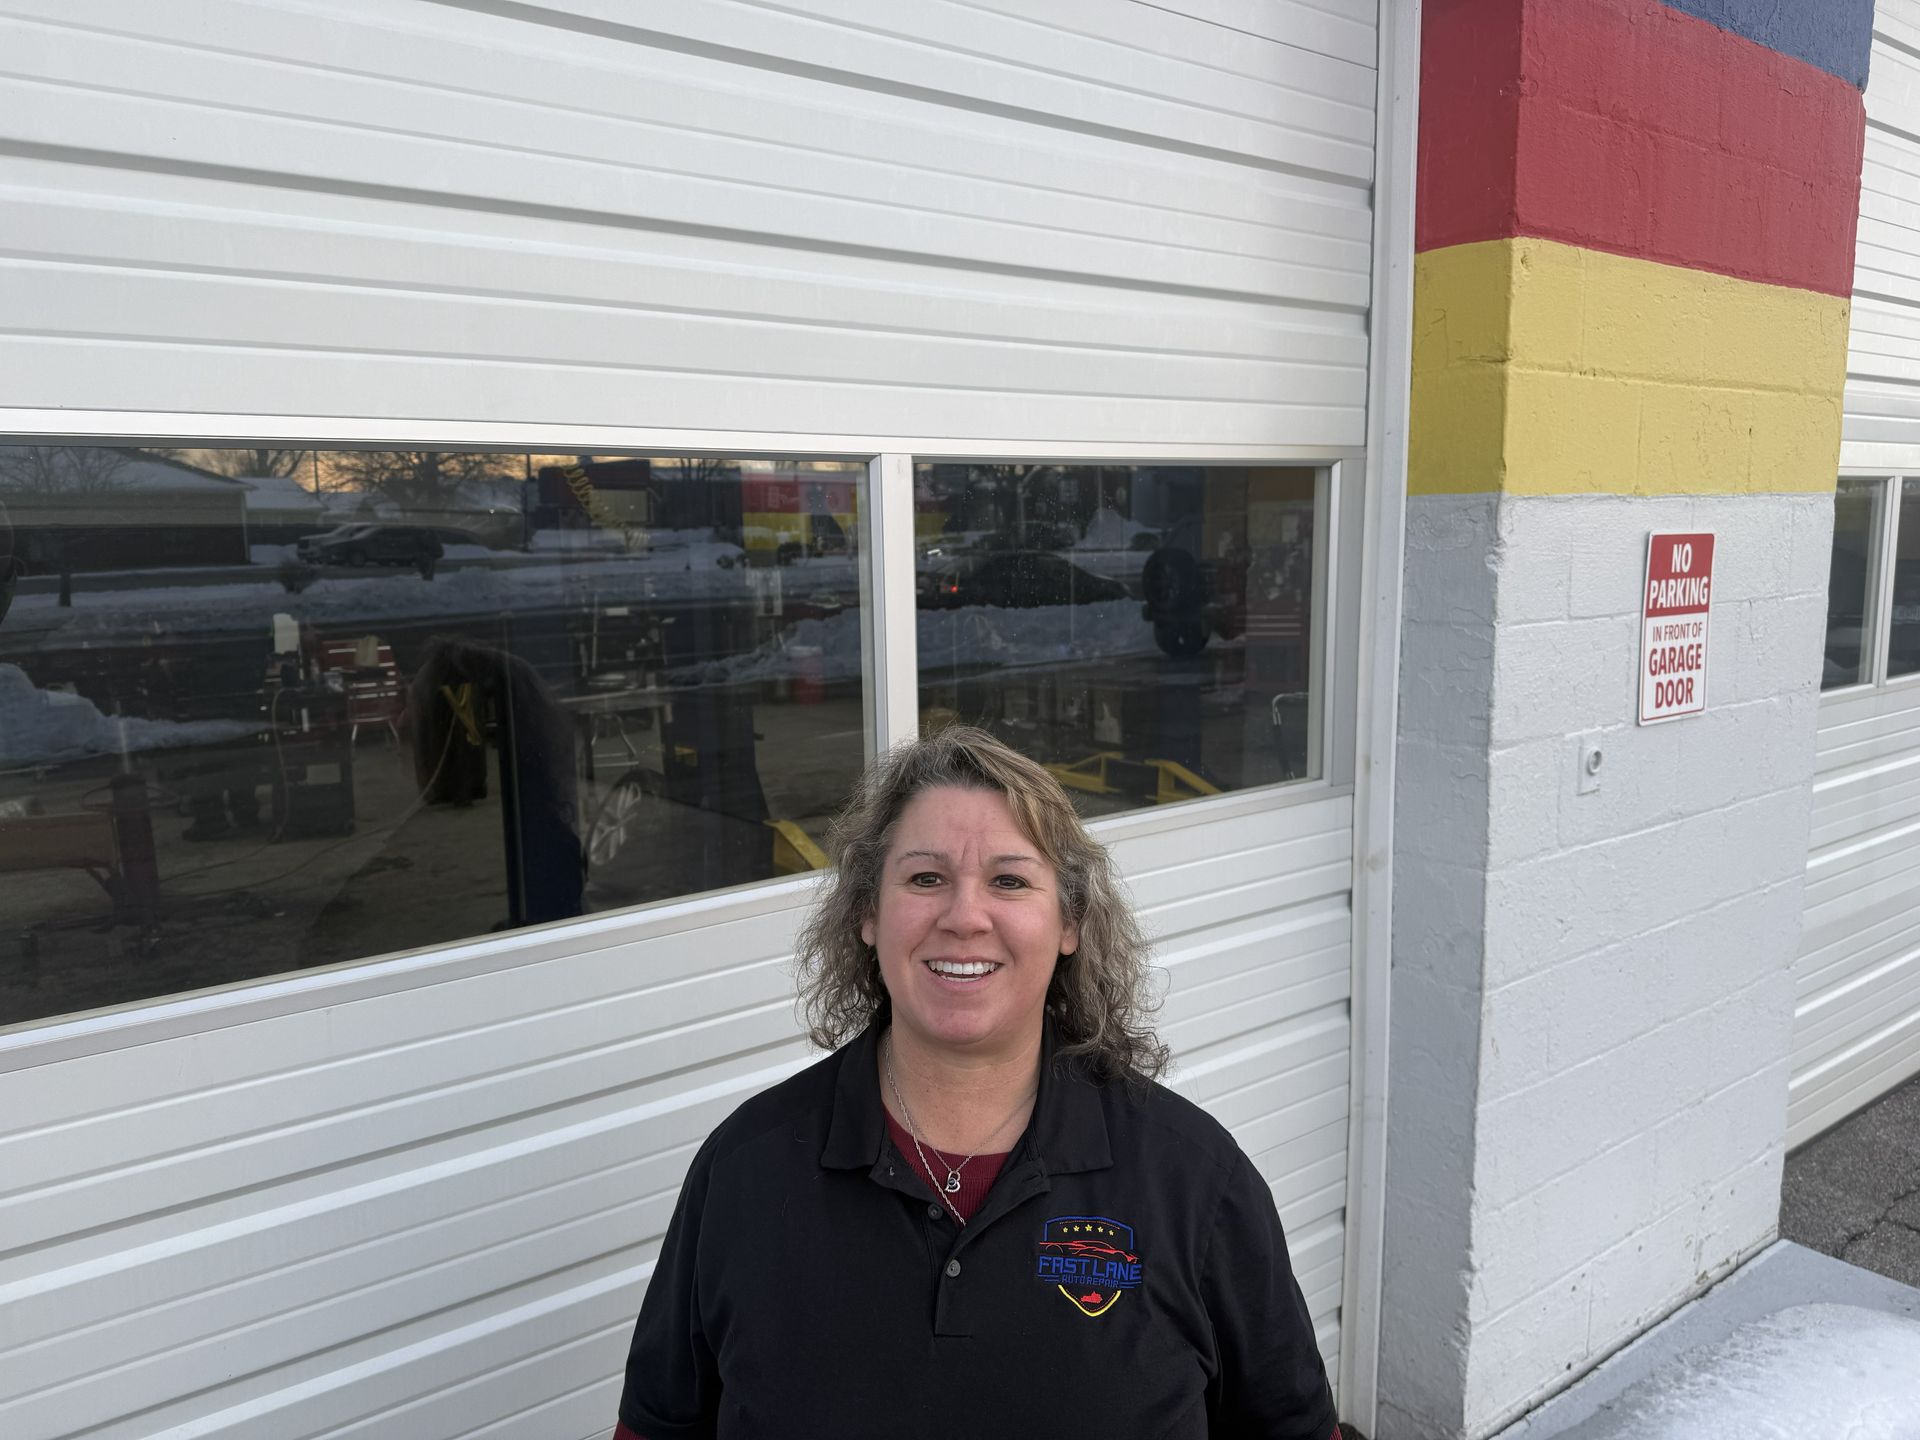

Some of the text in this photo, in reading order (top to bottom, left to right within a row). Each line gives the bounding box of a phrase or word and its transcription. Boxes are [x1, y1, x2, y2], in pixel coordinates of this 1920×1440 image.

[1671, 543, 1692, 573] NO
[1648, 575, 1709, 610] PARKING
[1652, 622, 1703, 642] IN FRONT OF
[1649, 643, 1703, 676] GARAGE
[1655, 677, 1694, 709] DOOR
